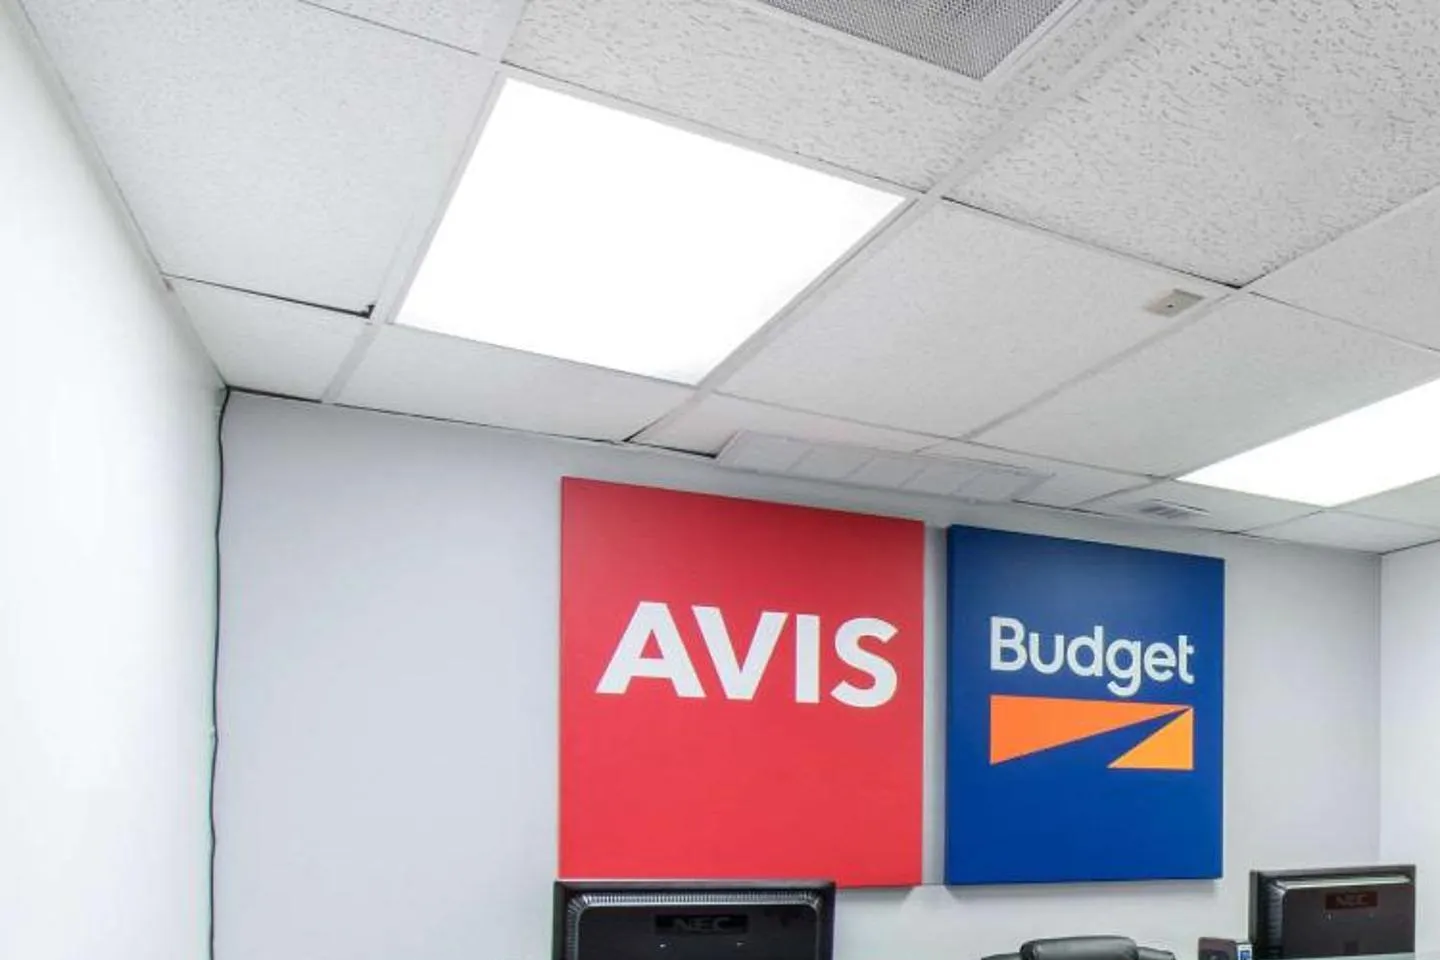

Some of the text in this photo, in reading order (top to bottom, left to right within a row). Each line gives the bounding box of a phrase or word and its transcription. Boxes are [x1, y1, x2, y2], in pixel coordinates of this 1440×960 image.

[595, 601, 898, 707] AVIS
[990, 615, 1195, 697] Budget
[674, 916, 731, 933] NEC
[1335, 893, 1369, 908] NEC
